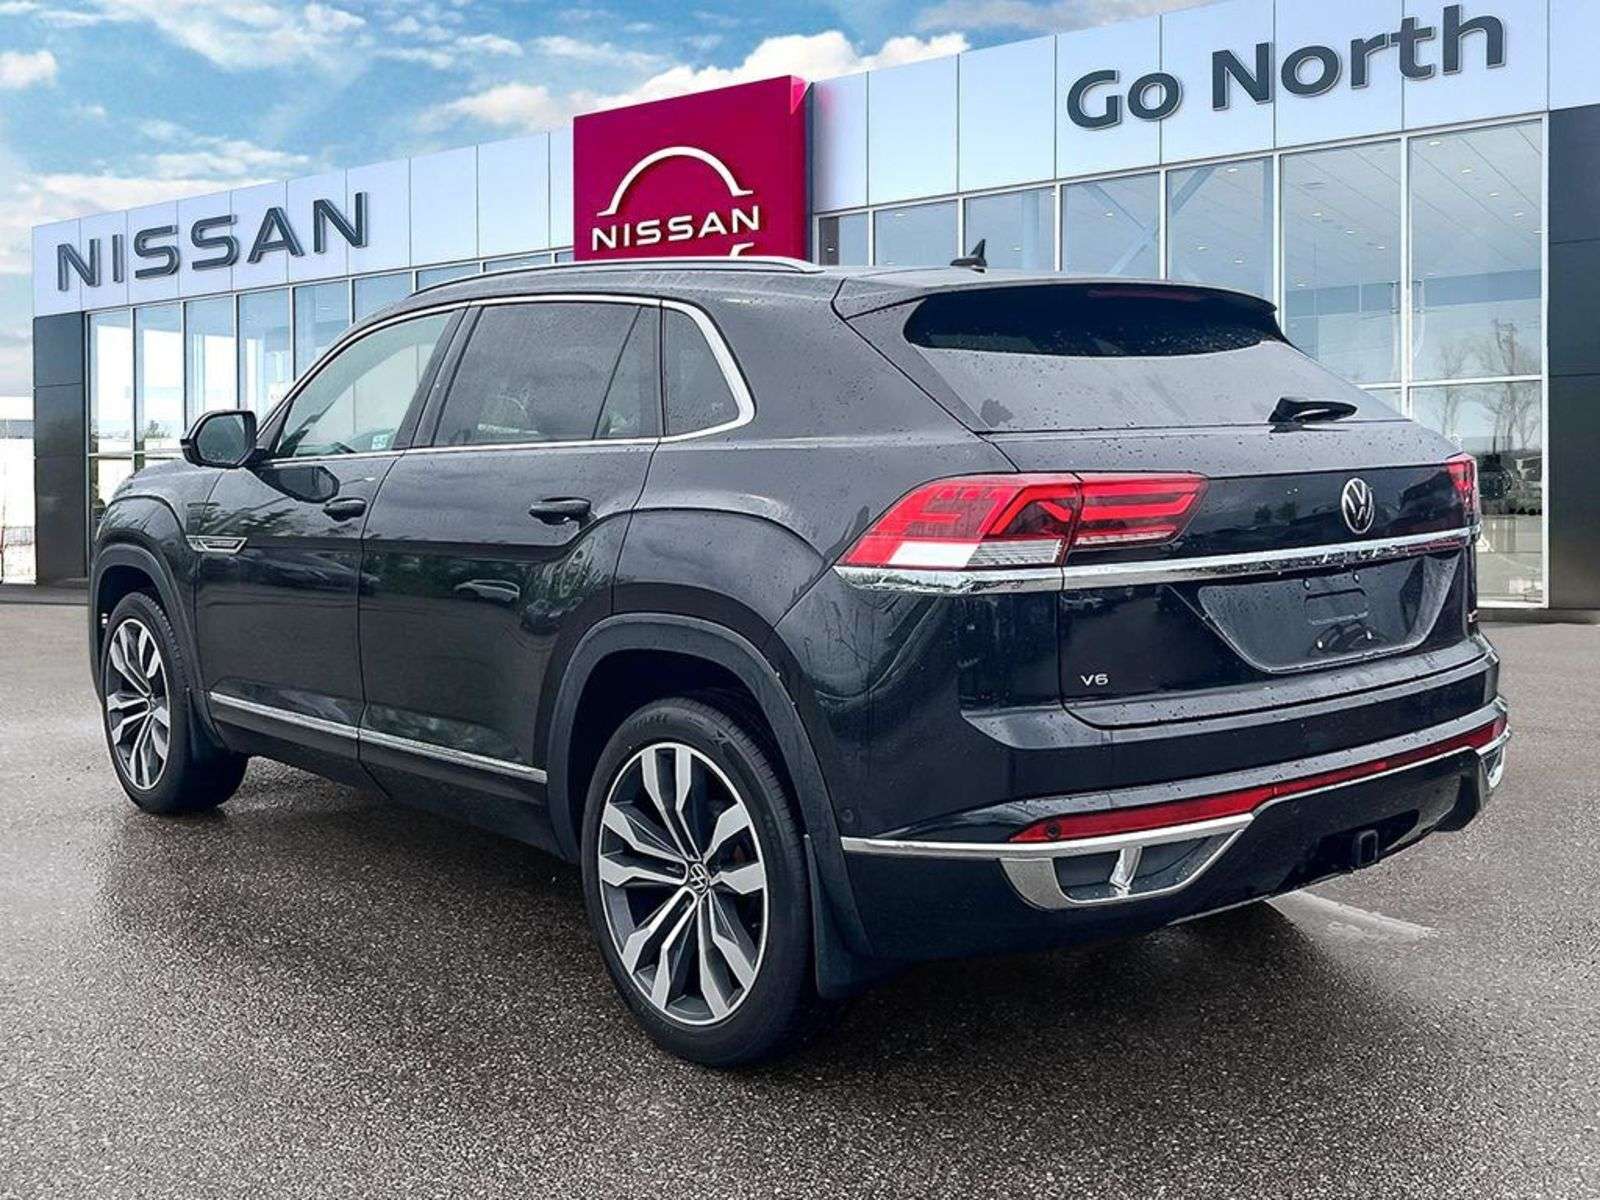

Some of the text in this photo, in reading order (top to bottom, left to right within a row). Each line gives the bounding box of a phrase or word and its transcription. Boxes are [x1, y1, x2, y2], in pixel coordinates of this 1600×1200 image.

[1066, 3, 1507, 130] Go North
[57, 191, 369, 292] NISSAN
[591, 205, 760, 251] NISSAN
[1080, 674, 1109, 687] V6
